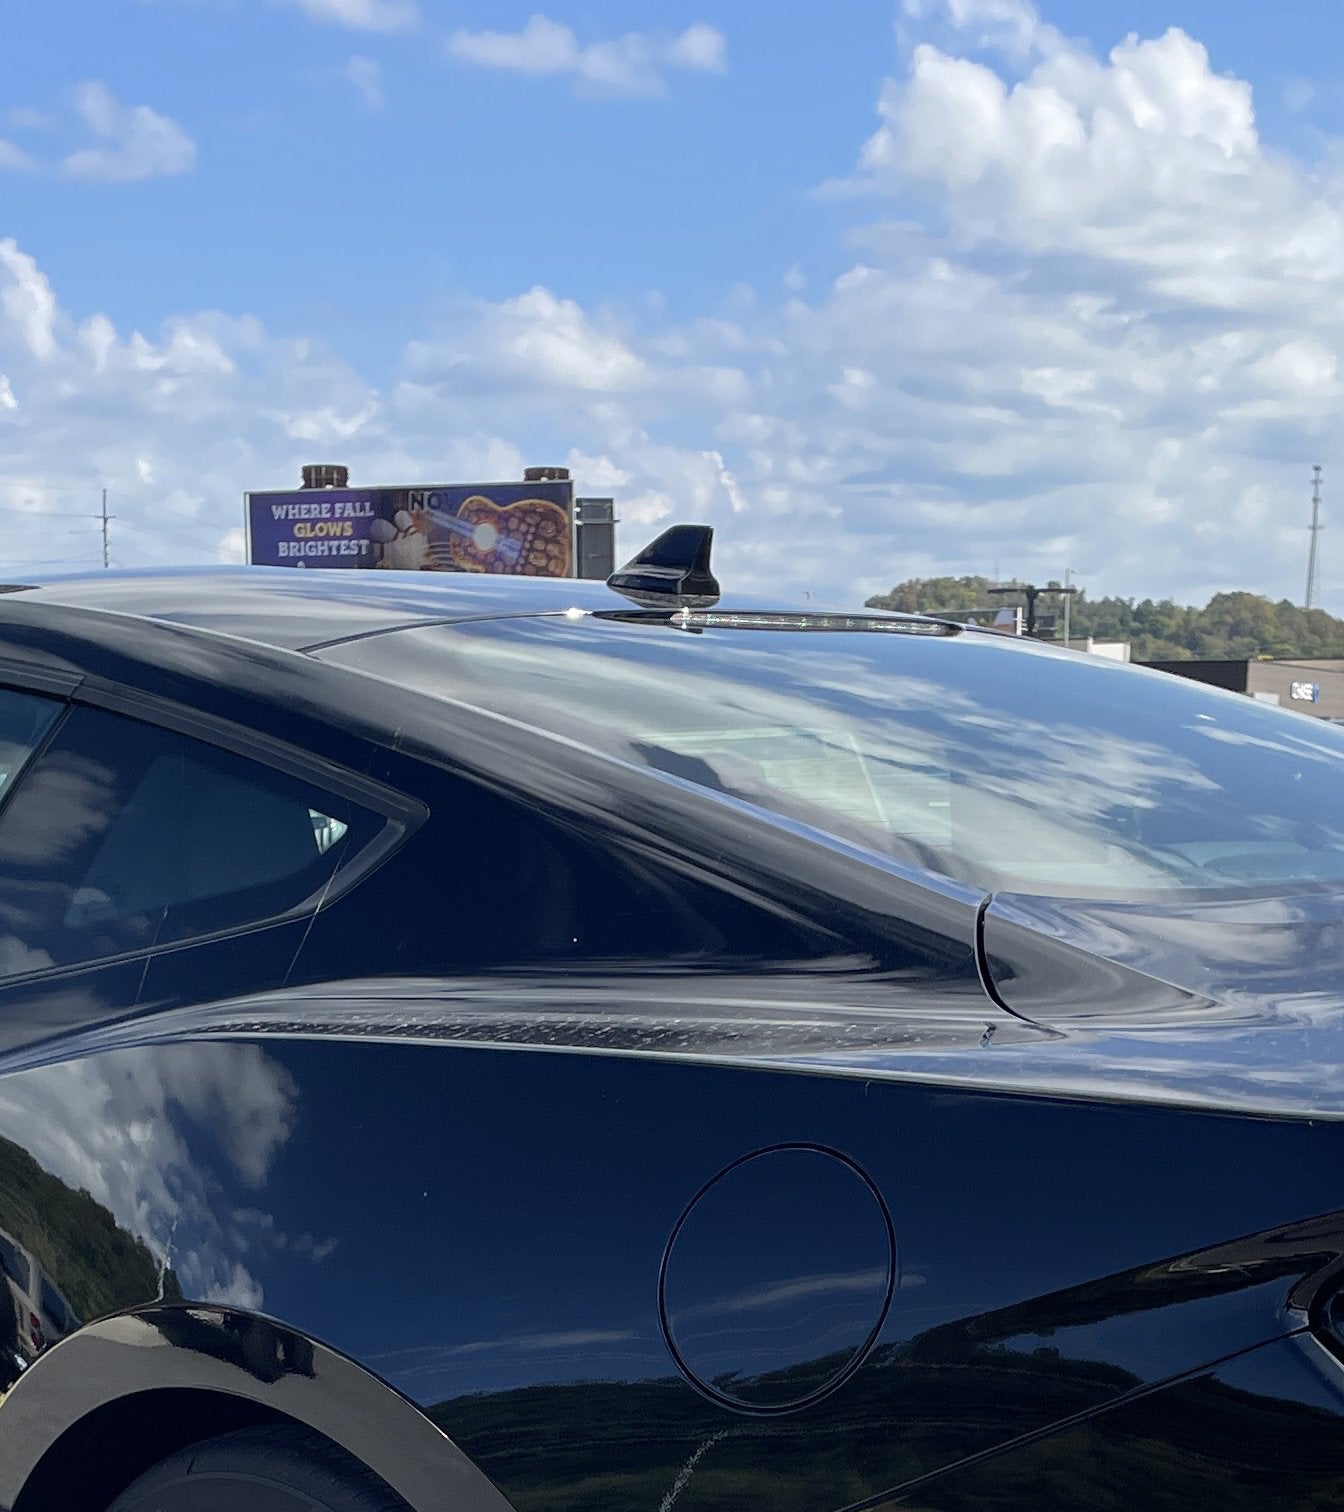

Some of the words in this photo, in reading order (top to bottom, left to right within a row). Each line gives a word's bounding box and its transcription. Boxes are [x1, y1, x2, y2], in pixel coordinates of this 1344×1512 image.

[271, 503, 331, 520] WHERE
[334, 502, 375, 518] FALL
[293, 521, 353, 538] GLOWS
[277, 539, 370, 557] BRIGHTEST
